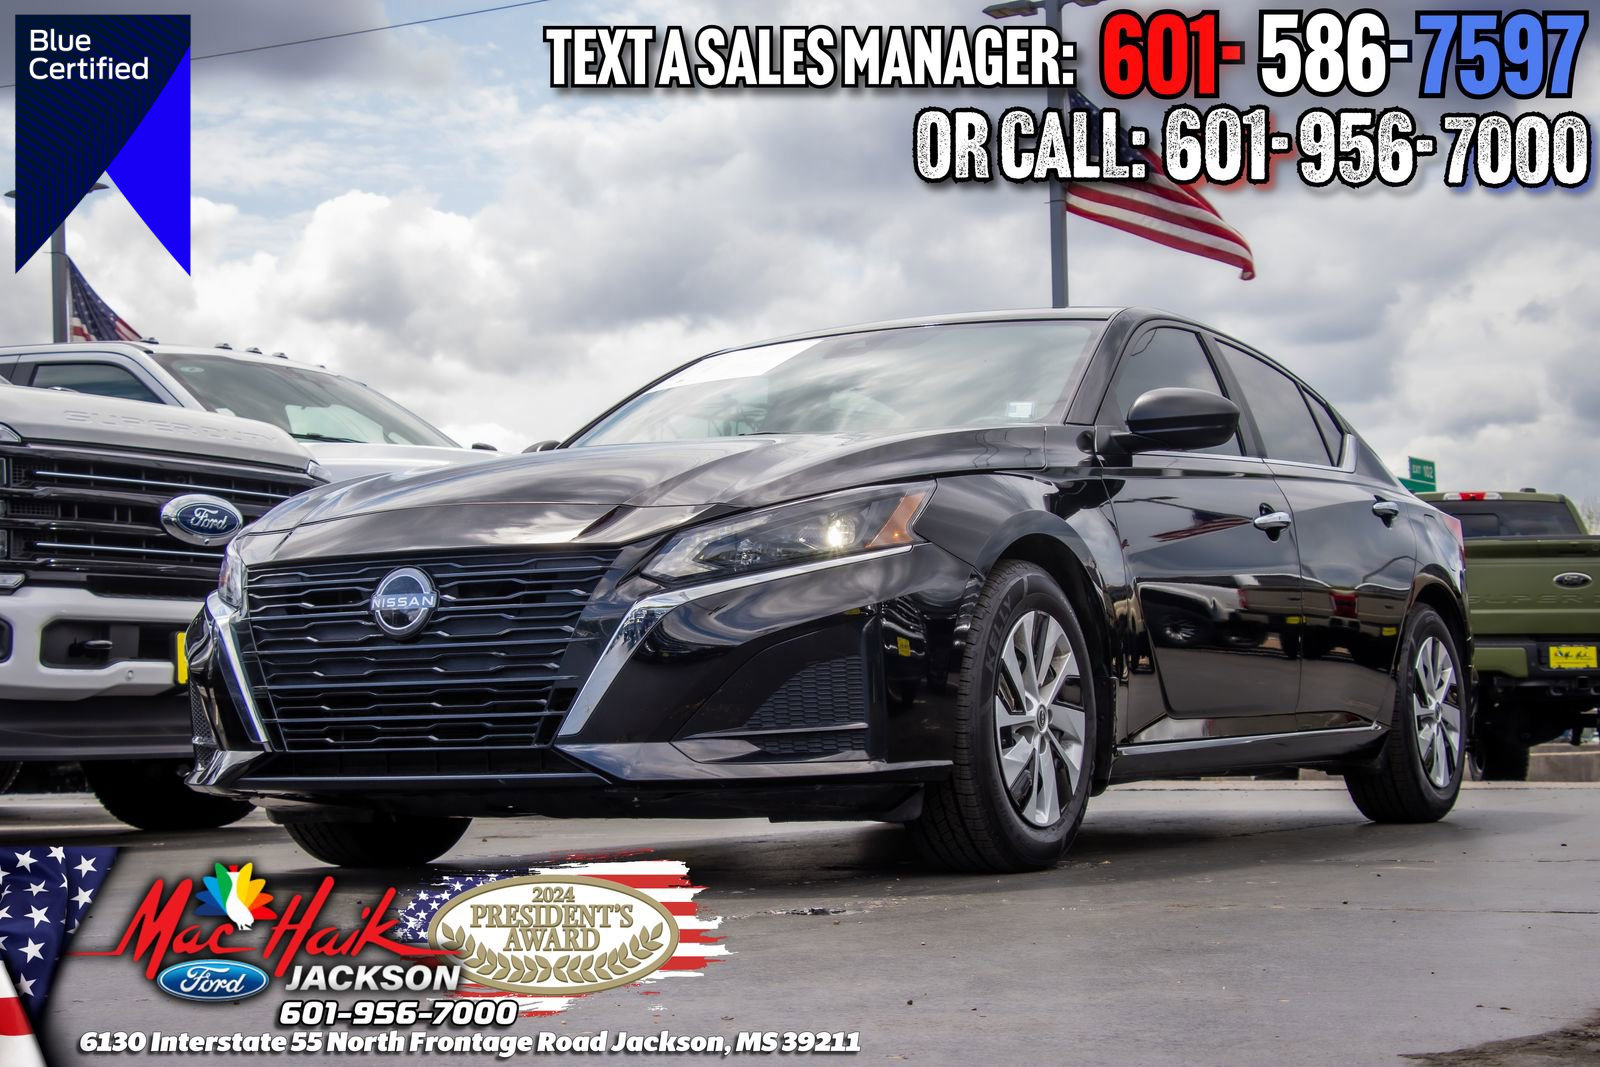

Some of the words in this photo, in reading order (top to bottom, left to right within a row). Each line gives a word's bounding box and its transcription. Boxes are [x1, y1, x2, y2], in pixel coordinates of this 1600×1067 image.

[190, 507, 228, 530] Ford
[371, 595, 434, 608] NISSAN
[985, 594, 1012, 673] KELLY
